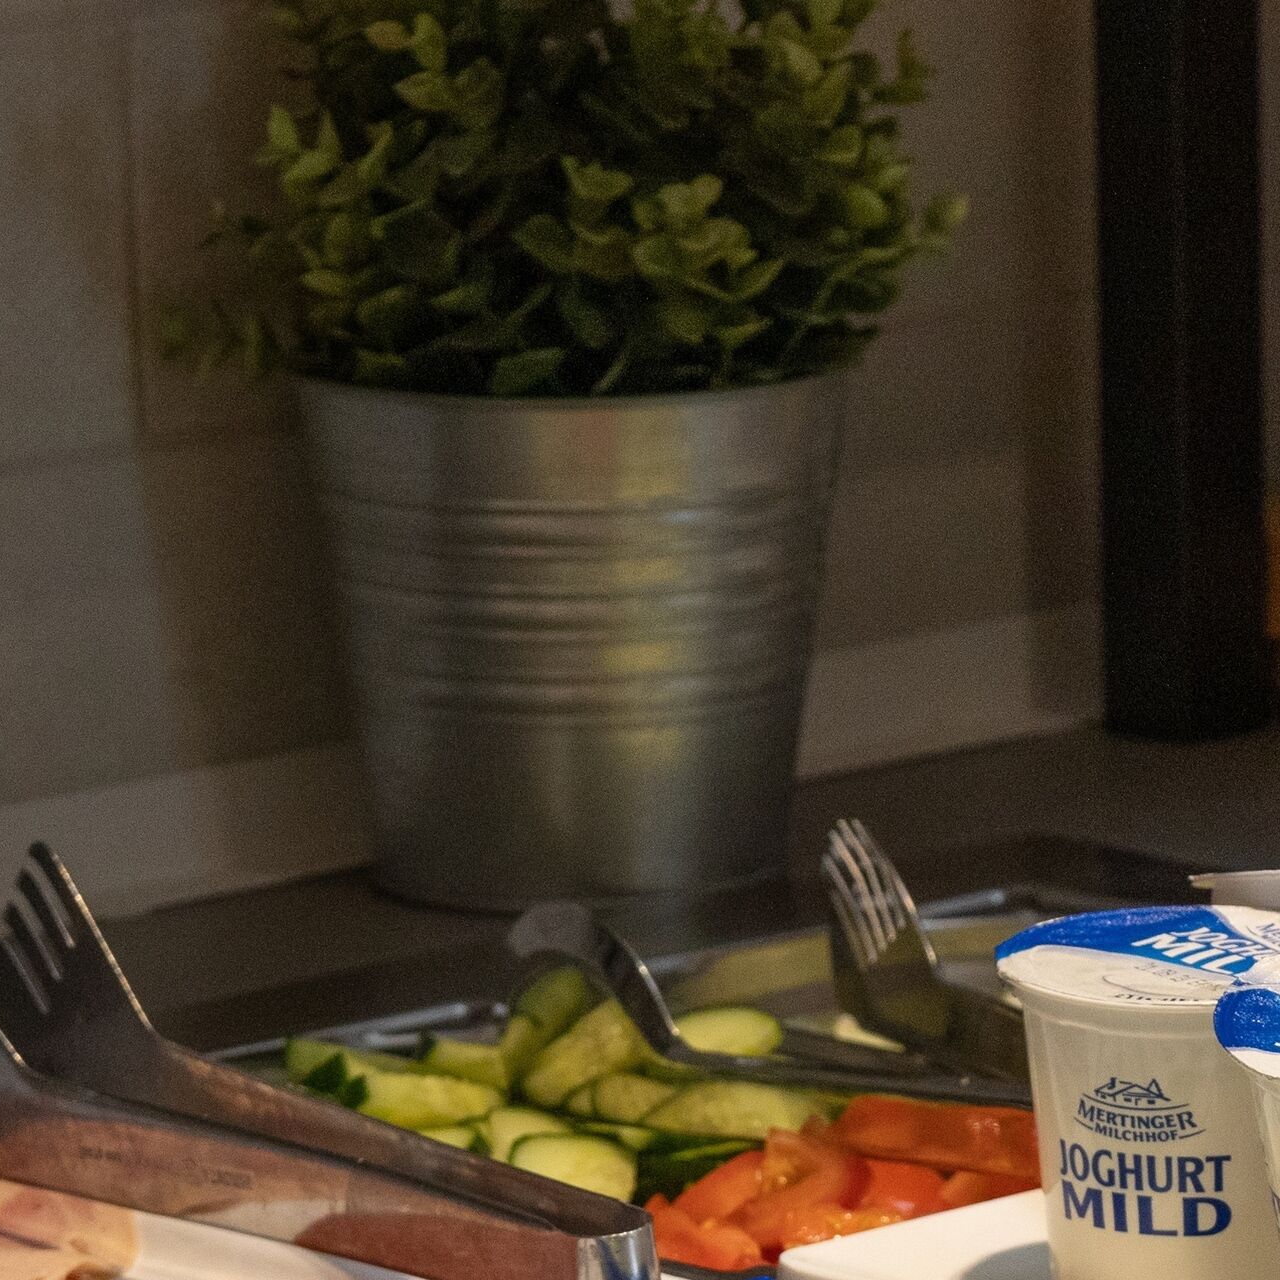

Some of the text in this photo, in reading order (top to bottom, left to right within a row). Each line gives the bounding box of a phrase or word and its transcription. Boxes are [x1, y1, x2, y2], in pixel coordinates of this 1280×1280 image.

[1078, 1099, 1198, 1129] MERTINGER
[1093, 1122, 1179, 1142] MILCHHOF
[1059, 1138, 1232, 1193] JOGHURT
[1061, 1179, 1233, 1237] MILD
